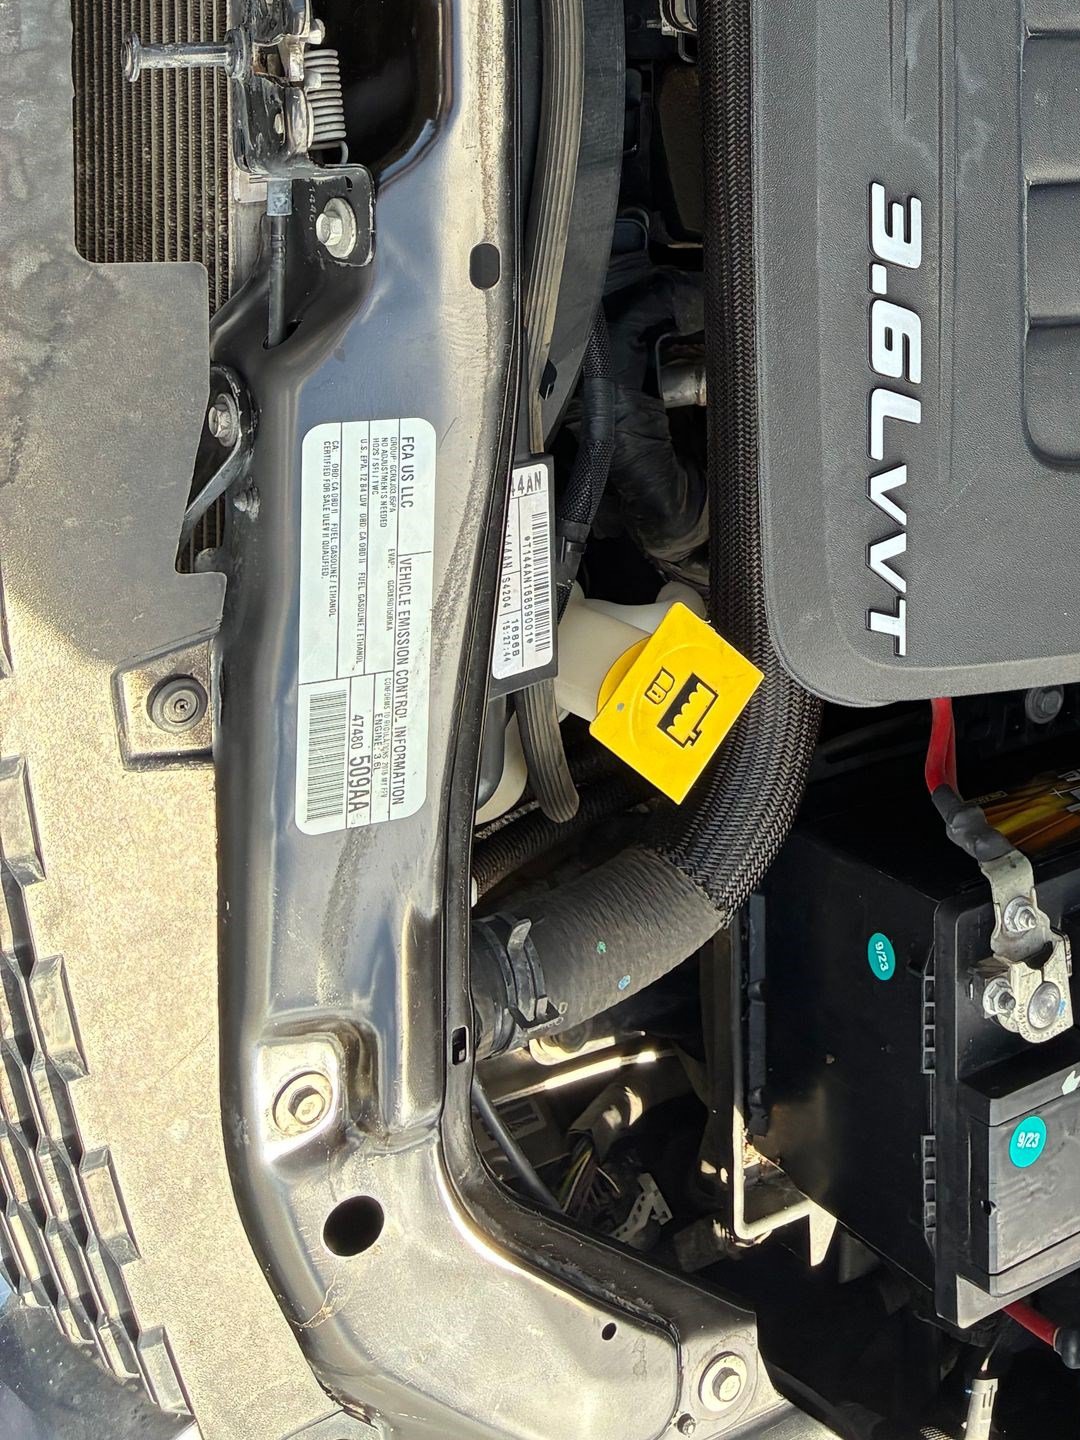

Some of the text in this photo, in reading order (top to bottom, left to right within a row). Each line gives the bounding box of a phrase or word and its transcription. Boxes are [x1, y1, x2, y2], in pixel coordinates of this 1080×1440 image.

[865, 182, 922, 656] 3.6L VVT
[323, 441, 331, 477] CERTIFIED
[360, 439, 368, 453] U.S.
[389, 437, 397, 462] GROUP:
[331, 482, 338, 491] CA
[379, 437, 388, 528] NO ADJUSTMENTS NEEDED
[400, 436, 414, 508] FCA US LLC
[322, 513, 330, 532] ULEV
[359, 532, 366, 541] CA
[321, 540, 329, 579] QUALIFIED.
[330, 545, 338, 579] GASOLINE
[502, 577, 510, 608] S4204
[357, 593, 365, 627] GASOLINE
[355, 634, 364, 664] ETHANOL
[383, 678, 391, 709] CONFORMS
[392, 558, 412, 806] VEHICLE EMISSION CONTROL INFORMATION
[373, 713, 383, 772] ENGINE: 3.6L
[382, 719, 390, 760] REGULATIONS
[349, 715, 370, 813] 47480 509AA
[874, 942, 888, 972] 9/23
[1016, 1131, 1040, 1148] 9/23
